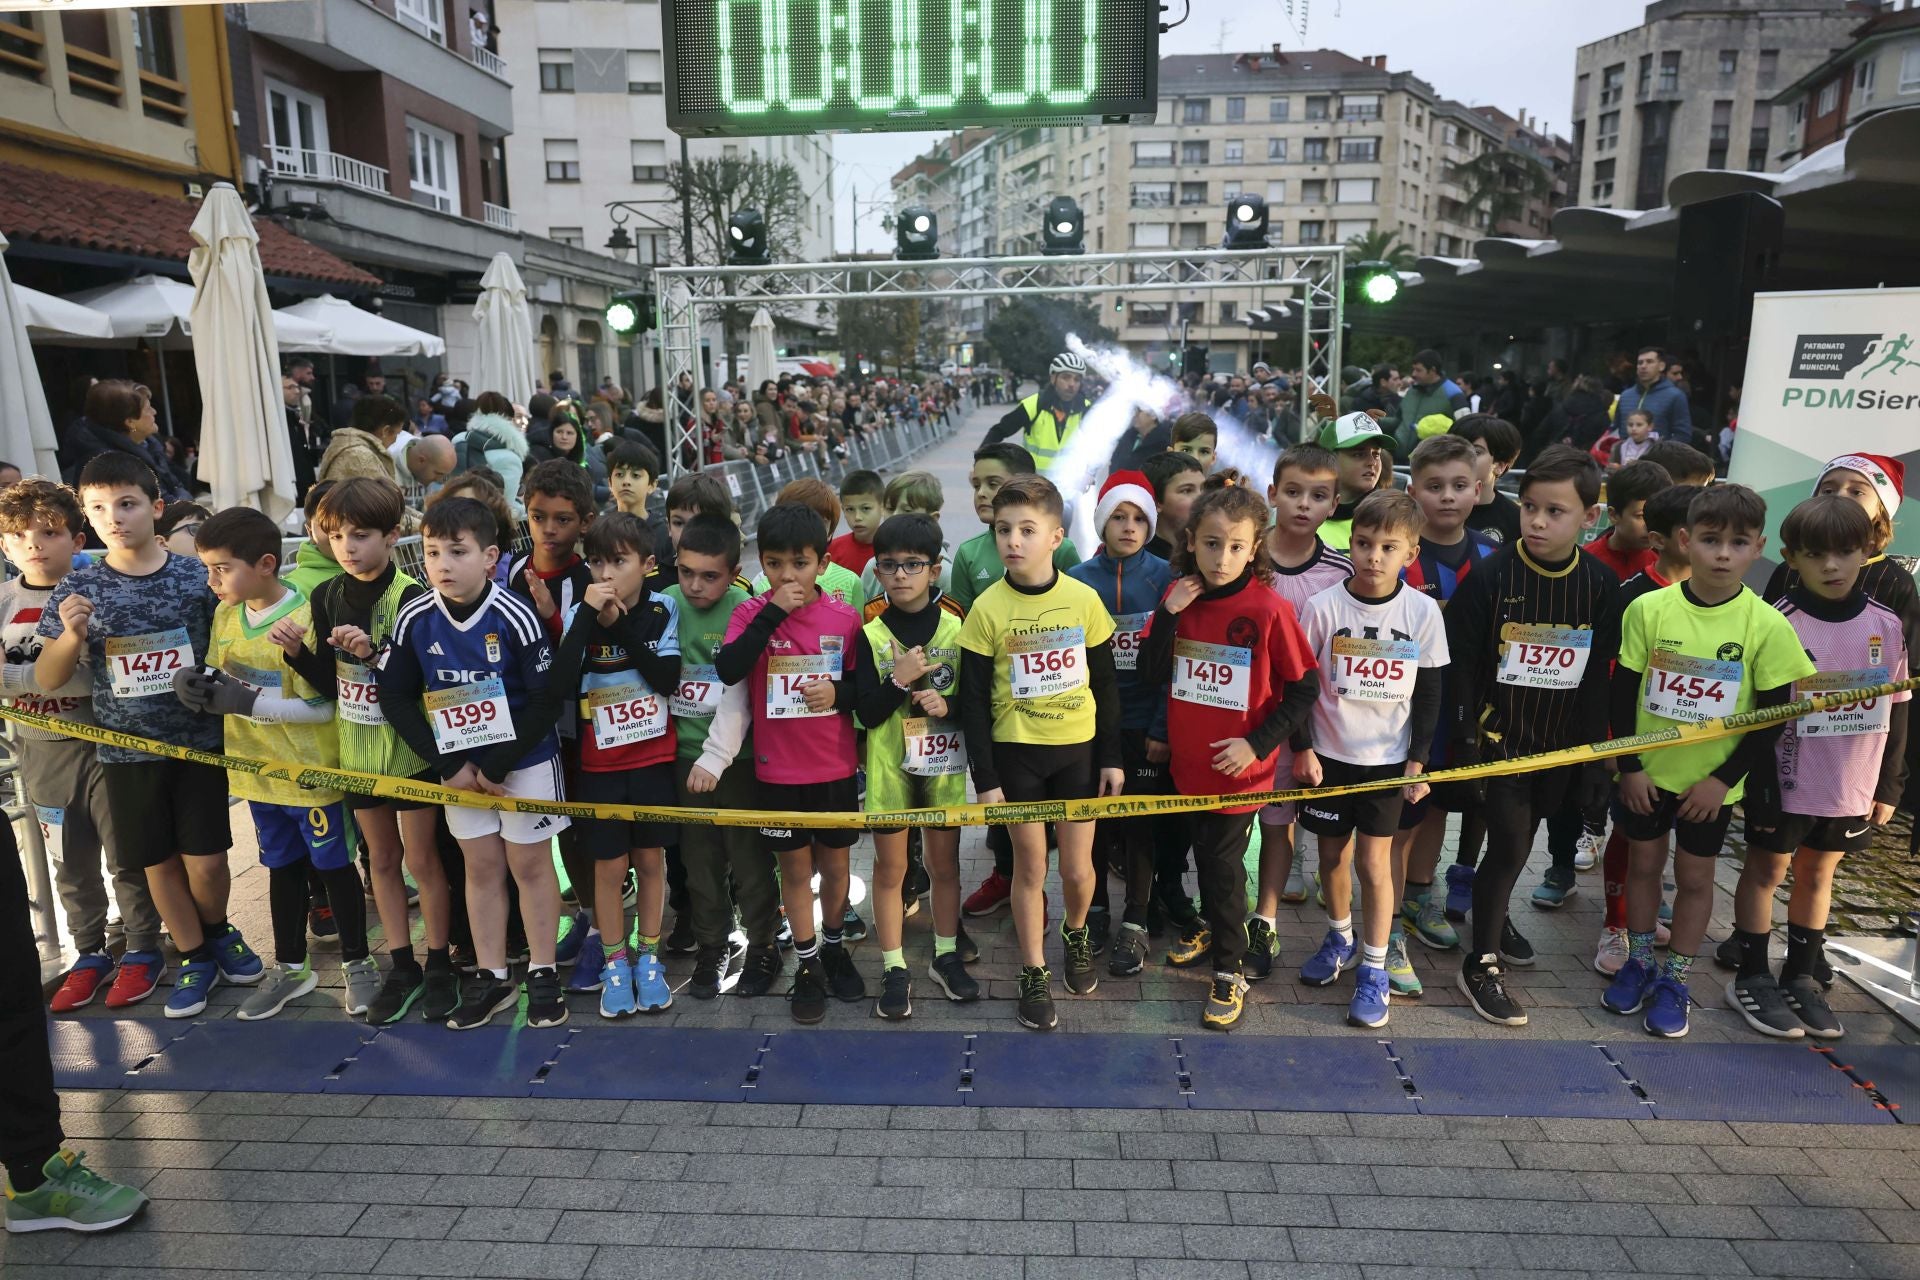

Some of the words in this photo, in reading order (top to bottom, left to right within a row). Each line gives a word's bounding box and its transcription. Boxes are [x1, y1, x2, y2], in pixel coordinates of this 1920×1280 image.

[1803, 342, 1845, 350] PATRONATO
[1801, 353, 1843, 361] DEPORTIVO
[1799, 363, 1840, 371] MUNICIPAL
[1782, 387, 1920, 410] PDMSier
[1416, 582, 1436, 591] BARÇA
[1511, 627, 1543, 638] Carrera
[1008, 638, 1037, 648] Carrera
[1040, 635, 1054, 644] Fin
[1336, 639, 1367, 649] Carrera
[1369, 643, 1382, 652] Fin
[1020, 648, 1075, 674] 1366
[1228, 650, 1246, 659] Año
[1519, 643, 1576, 668] 1370
[118, 649, 182, 676] 1472
[771, 659, 800, 668] Carrera
[1344, 657, 1404, 681] 1405
[1687, 659, 1702, 669] Fin
[136, 671, 170, 683] MARCO
[1186, 659, 1233, 686] 1419
[1527, 666, 1560, 676] PELAYO
[1360, 680, 1385, 688] NOAH
[1529, 676, 1573, 686] PDMSiero
[1840, 674, 1854, 682] Fin
[143, 681, 175, 693] PDMS
[336, 678, 379, 704] 1378
[1040, 679, 1080, 692] PDMSiero
[1196, 683, 1219, 693] ILLÁN
[1658, 671, 1724, 702] 1454
[428, 695, 455, 704] Carrera
[456, 689, 470, 698] Fin
[1196, 693, 1239, 707] PDMSiero
[1360, 689, 1404, 700] PDMSiero
[343, 701, 370, 711] MARTÍN
[674, 698, 697, 708] MARIO
[1676, 698, 1698, 708] ESPI
[440, 700, 497, 729] 1399
[604, 695, 659, 725] 1363
[1014, 705, 1064, 720] elregueru.es
[1724, 700, 1813, 729] FABRICADO
[1828, 712, 1863, 722] MARTÍN
[461, 724, 488, 735] OSCAR
[618, 718, 653, 732] MARIETE
[1833, 723, 1882, 733] PDMSiero
[112, 733, 150, 751] CAJA
[467, 732, 508, 745] PDMSiero
[917, 733, 960, 756] 1394
[1593, 730, 1680, 752] COMPROMETIDOS
[1783, 727, 1794, 775] OVIEDO
[186, 751, 219, 766] MEDIO
[223, 760, 234, 770] EL
[928, 756, 948, 764] DIEGO
[235, 762, 258, 774] CON
[314, 771, 375, 788] RECICLADO
[394, 785, 444, 801] ASTURIAS
[445, 793, 460, 803] DE
[526, 803, 594, 817] AMBIENTE
[986, 803, 1064, 816] COMPROMETIDOS
[1304, 805, 1339, 821] LEGEA
[307, 807, 329, 838] 9
[867, 811, 944, 823] FABRICADO
